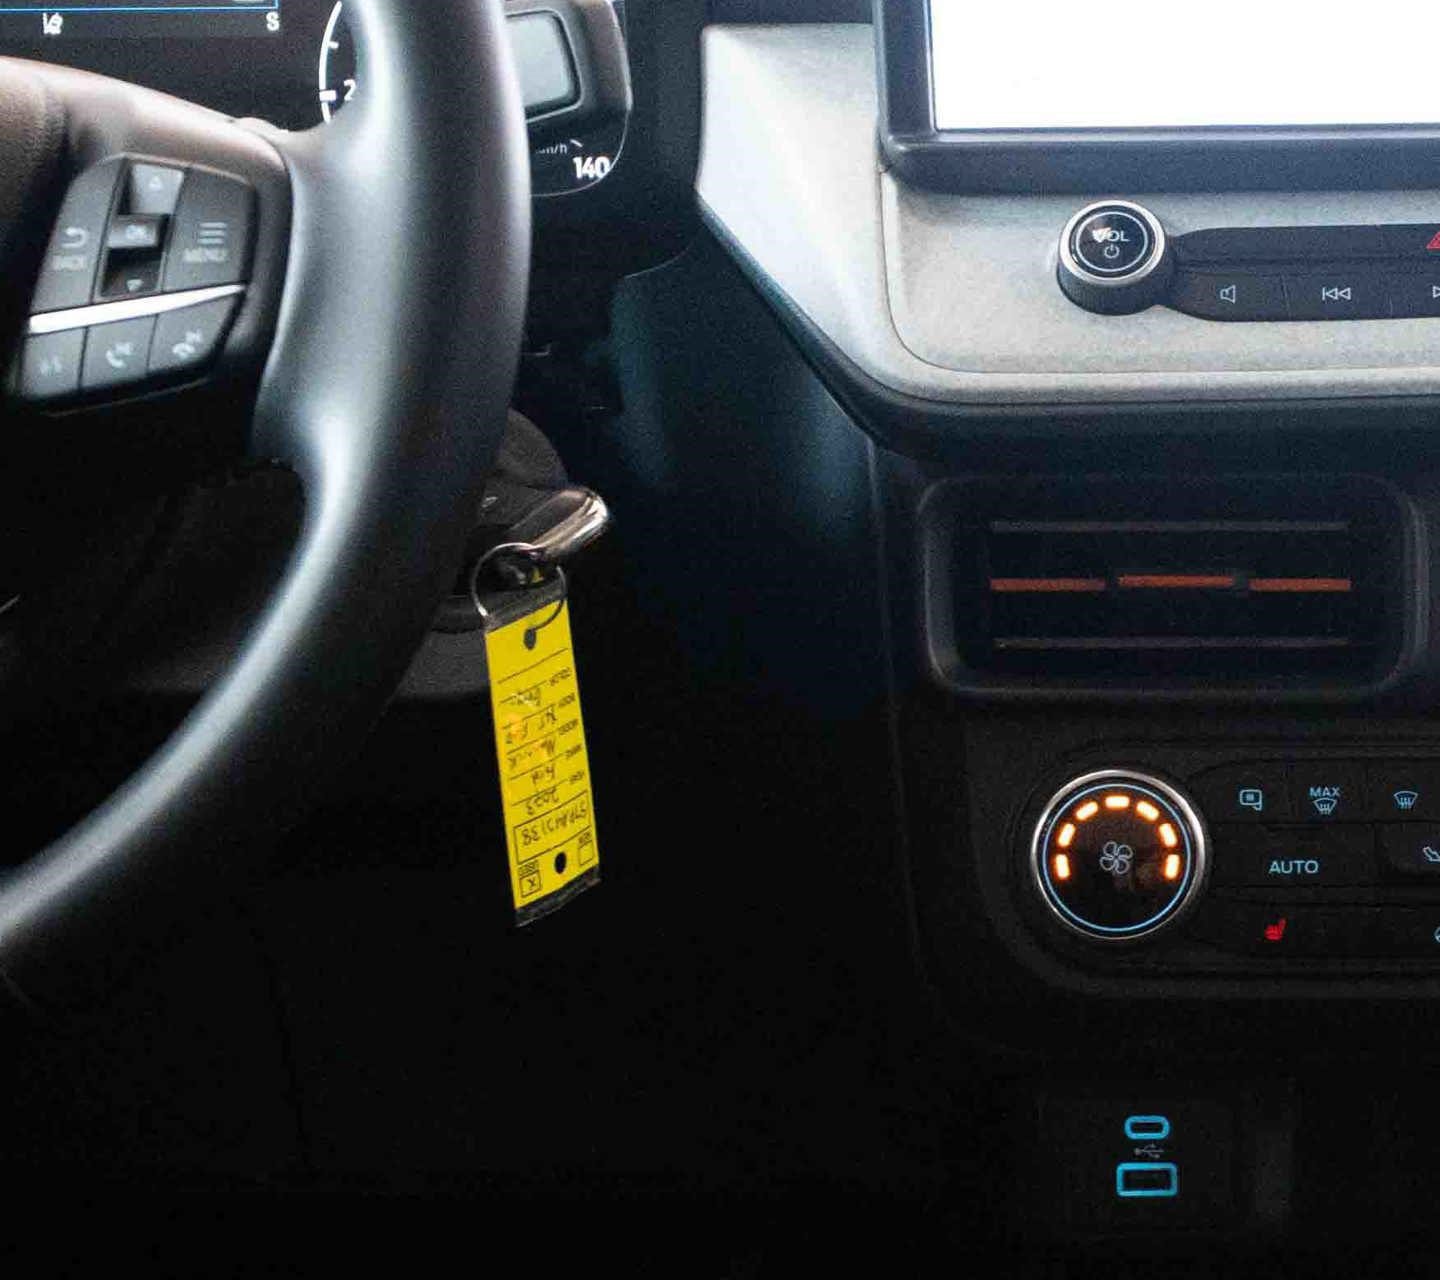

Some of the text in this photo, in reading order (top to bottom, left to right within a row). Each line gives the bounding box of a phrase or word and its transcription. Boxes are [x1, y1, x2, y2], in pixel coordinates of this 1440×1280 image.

[572, 155, 612, 180] 140
[1092, 227, 1131, 243] VOL
[1309, 786, 1340, 798] MAX
[1269, 859, 1320, 875] AUTO
